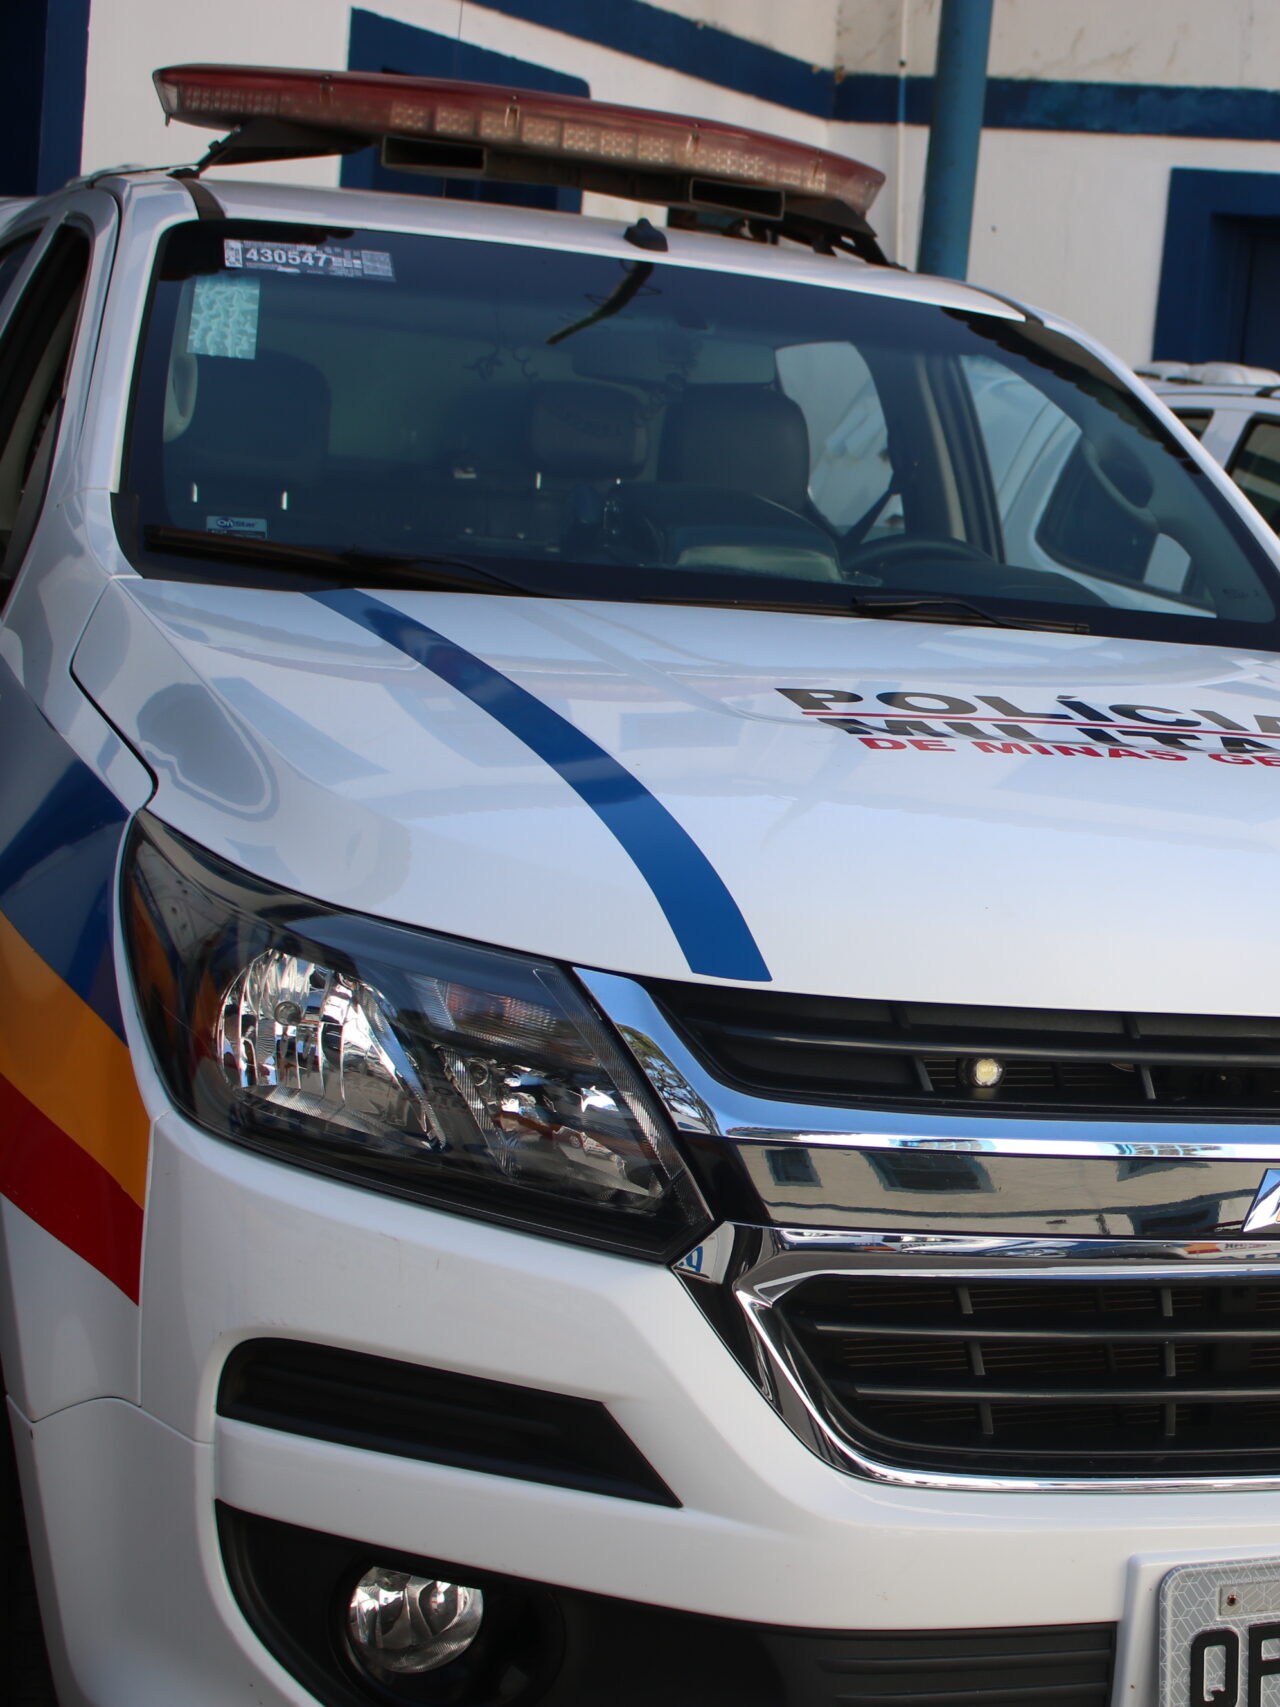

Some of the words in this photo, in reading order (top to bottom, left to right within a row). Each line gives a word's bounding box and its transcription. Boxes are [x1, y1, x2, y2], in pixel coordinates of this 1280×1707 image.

[246, 248, 331, 267] 430547
[858, 737, 956, 752] DE
[971, 740, 1188, 762] MINAS
